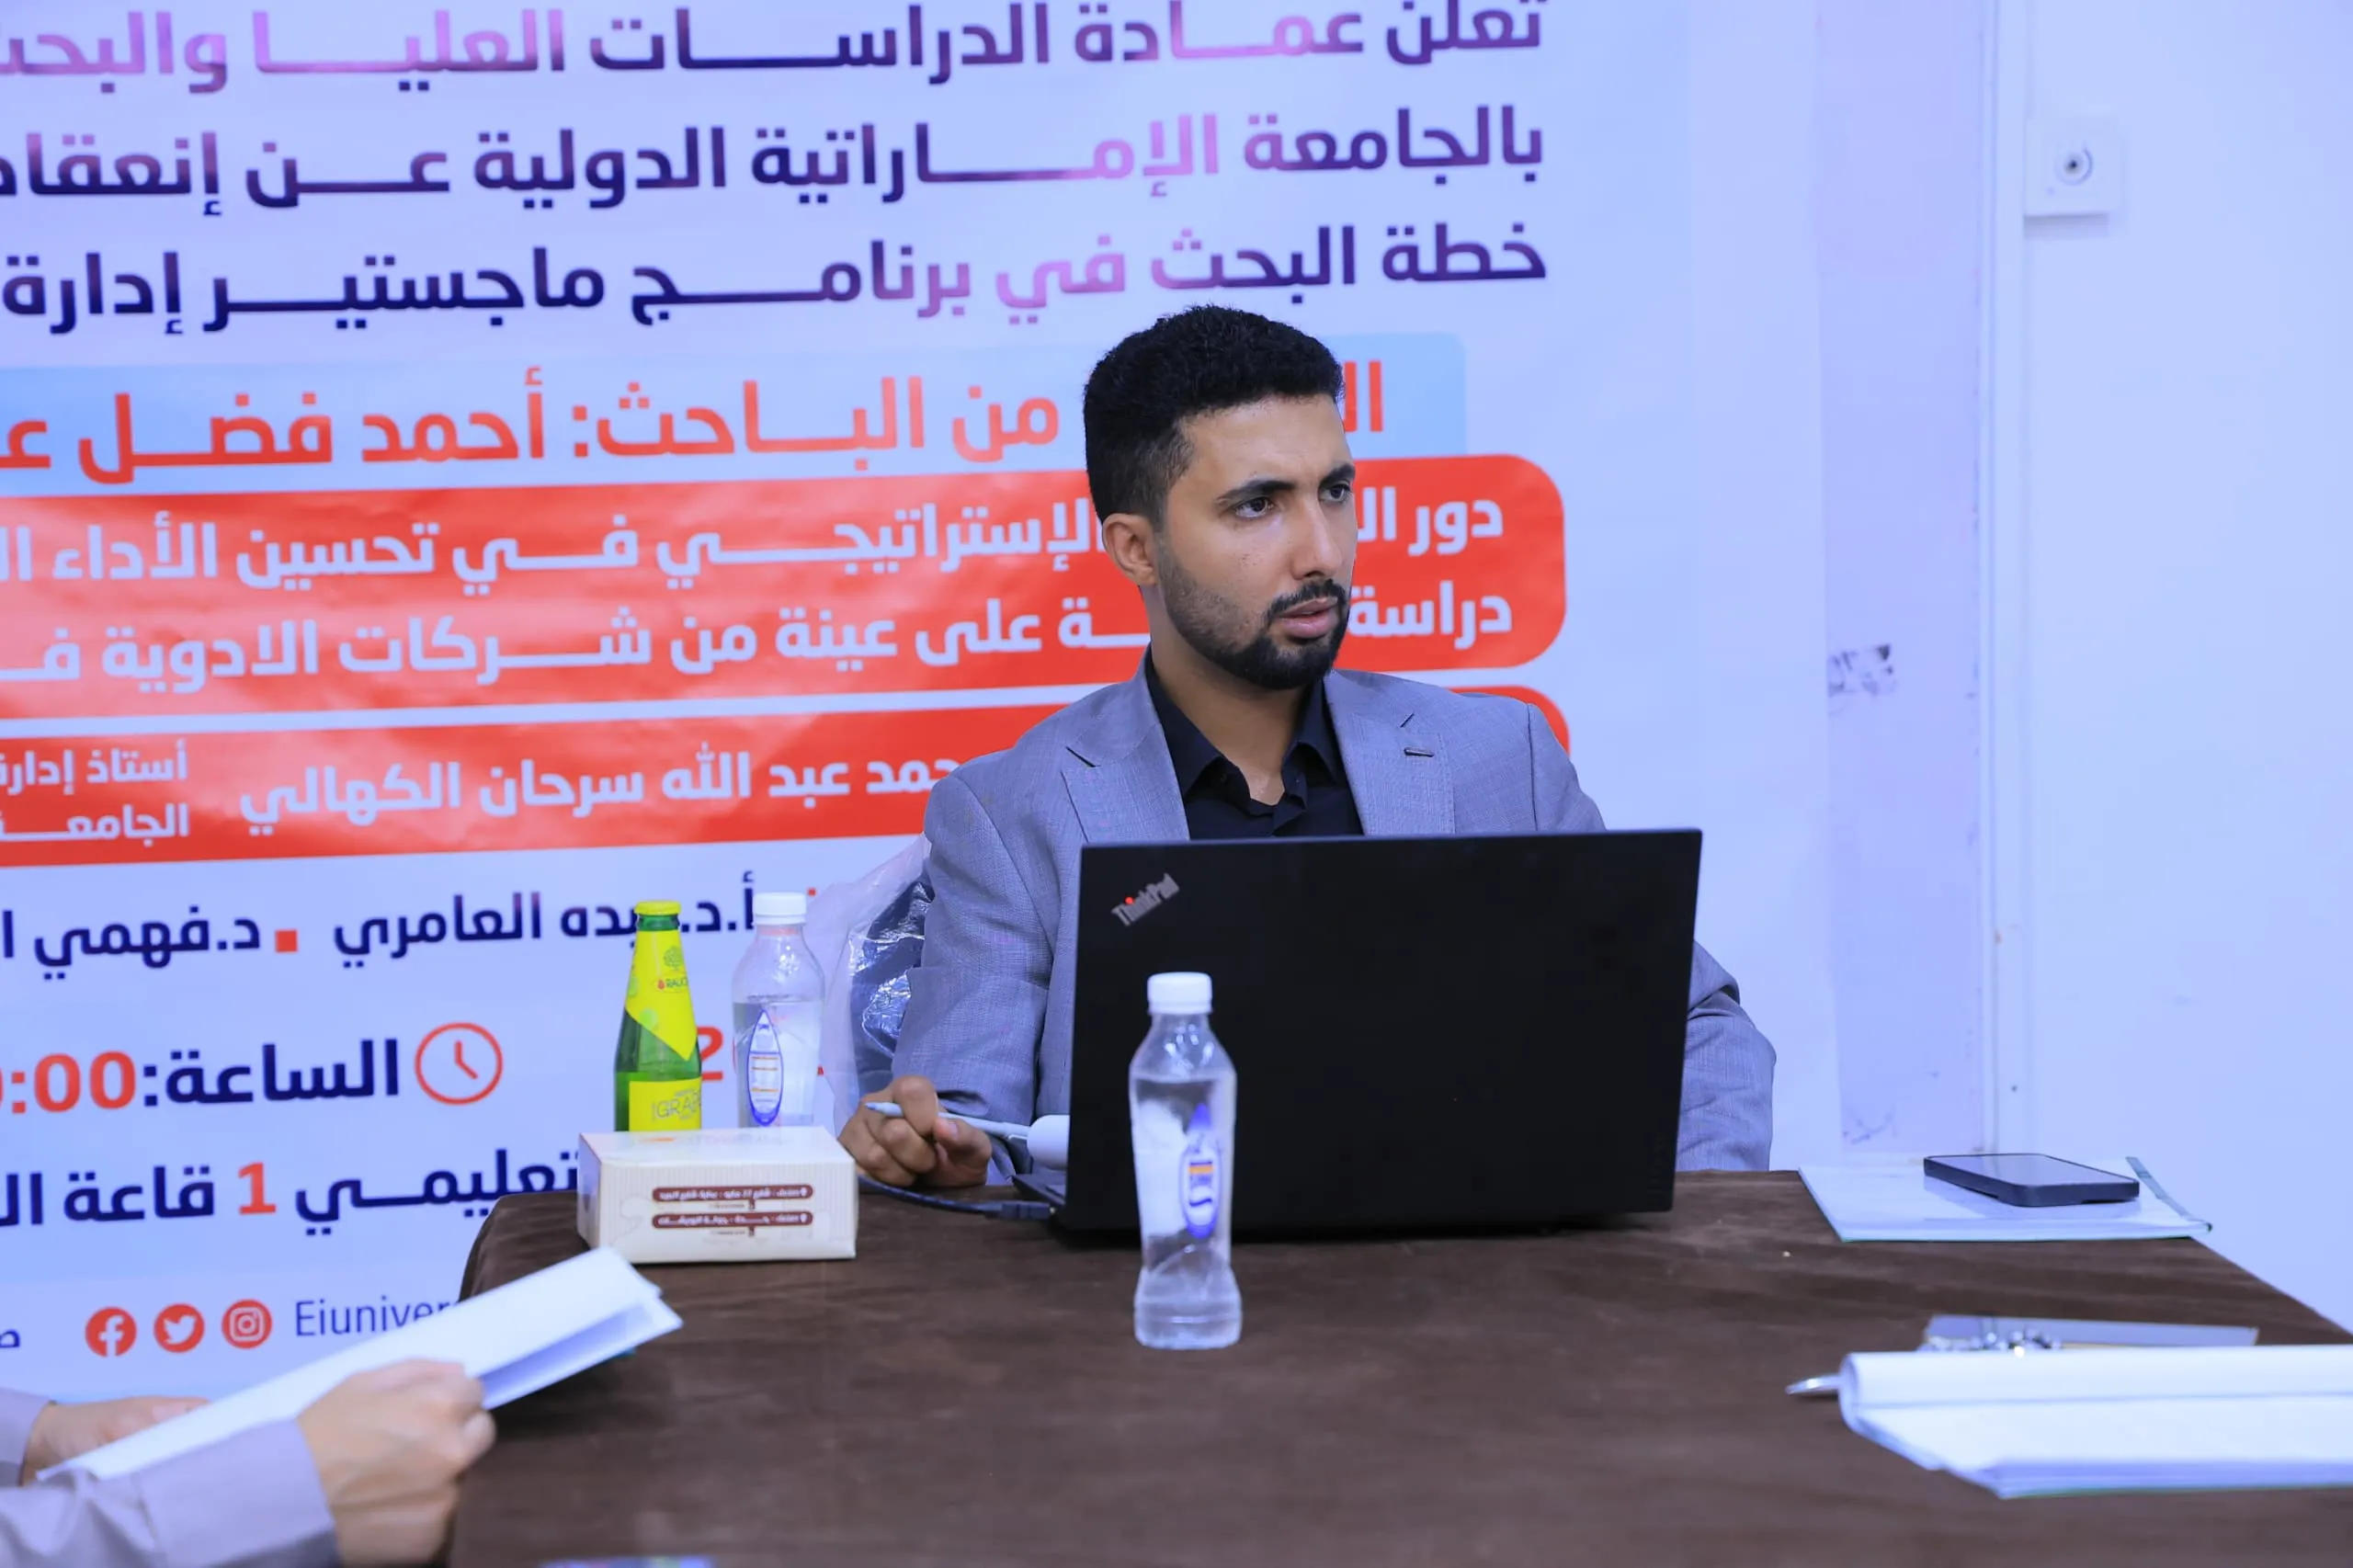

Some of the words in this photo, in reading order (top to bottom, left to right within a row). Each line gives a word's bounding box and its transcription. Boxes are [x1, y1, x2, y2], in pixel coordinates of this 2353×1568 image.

[0, 12, 229, 95] والبح
[255, 9, 564, 93] العليا
[590, 3, 1050, 85] الدراسات
[1074, 0, 1364, 63] عمادة
[1386, 0, 1540, 66] تعلن
[245, 143, 450, 210] عن
[474, 127, 726, 210] الدولية
[750, 113, 1219, 205] الإماراتية
[1245, 105, 1542, 186] بالجامعة
[631, 240, 969, 327] برنامج
[995, 234, 1126, 325] في
[1150, 225, 1356, 304] البحث
[1381, 222, 1547, 283] خطة
[2, 252, 183, 335] إدارة
[202, 247, 605, 333] ماجستير
[78, 392, 333, 485] فضل
[361, 367, 544, 463] أحمد
[573, 377, 925, 472] الباحث:
[952, 386, 1060, 463] من
[51, 511, 219, 581] الأداء
[235, 522, 440, 592] تحسين
[452, 514, 641, 597] في
[1407, 499, 1504, 556] دور
[338, 606, 652, 686] شركات
[670, 616, 757, 675] من
[776, 607, 898, 672] عينة
[915, 597, 1042, 666] على
[1347, 580, 1513, 650] دراسة
[101, 618, 319, 695] الادوية
[84, 733, 190, 783] أستاذ
[475, 759, 645, 819] سرحان
[661, 742, 751, 801] الله
[768, 762, 850, 809] عبد
[867, 758, 961, 794] حمد
[0, 801, 189, 847] الجامع
[239, 762, 462, 835] الكهالي
[334, 892, 541, 969] العامري
[1110, 871, 1180, 926] ThinkPad
[34, 905, 260, 981] د.فهمي
[63, 1165, 214, 1222] قاعة
[237, 1162, 276, 1214] 1
